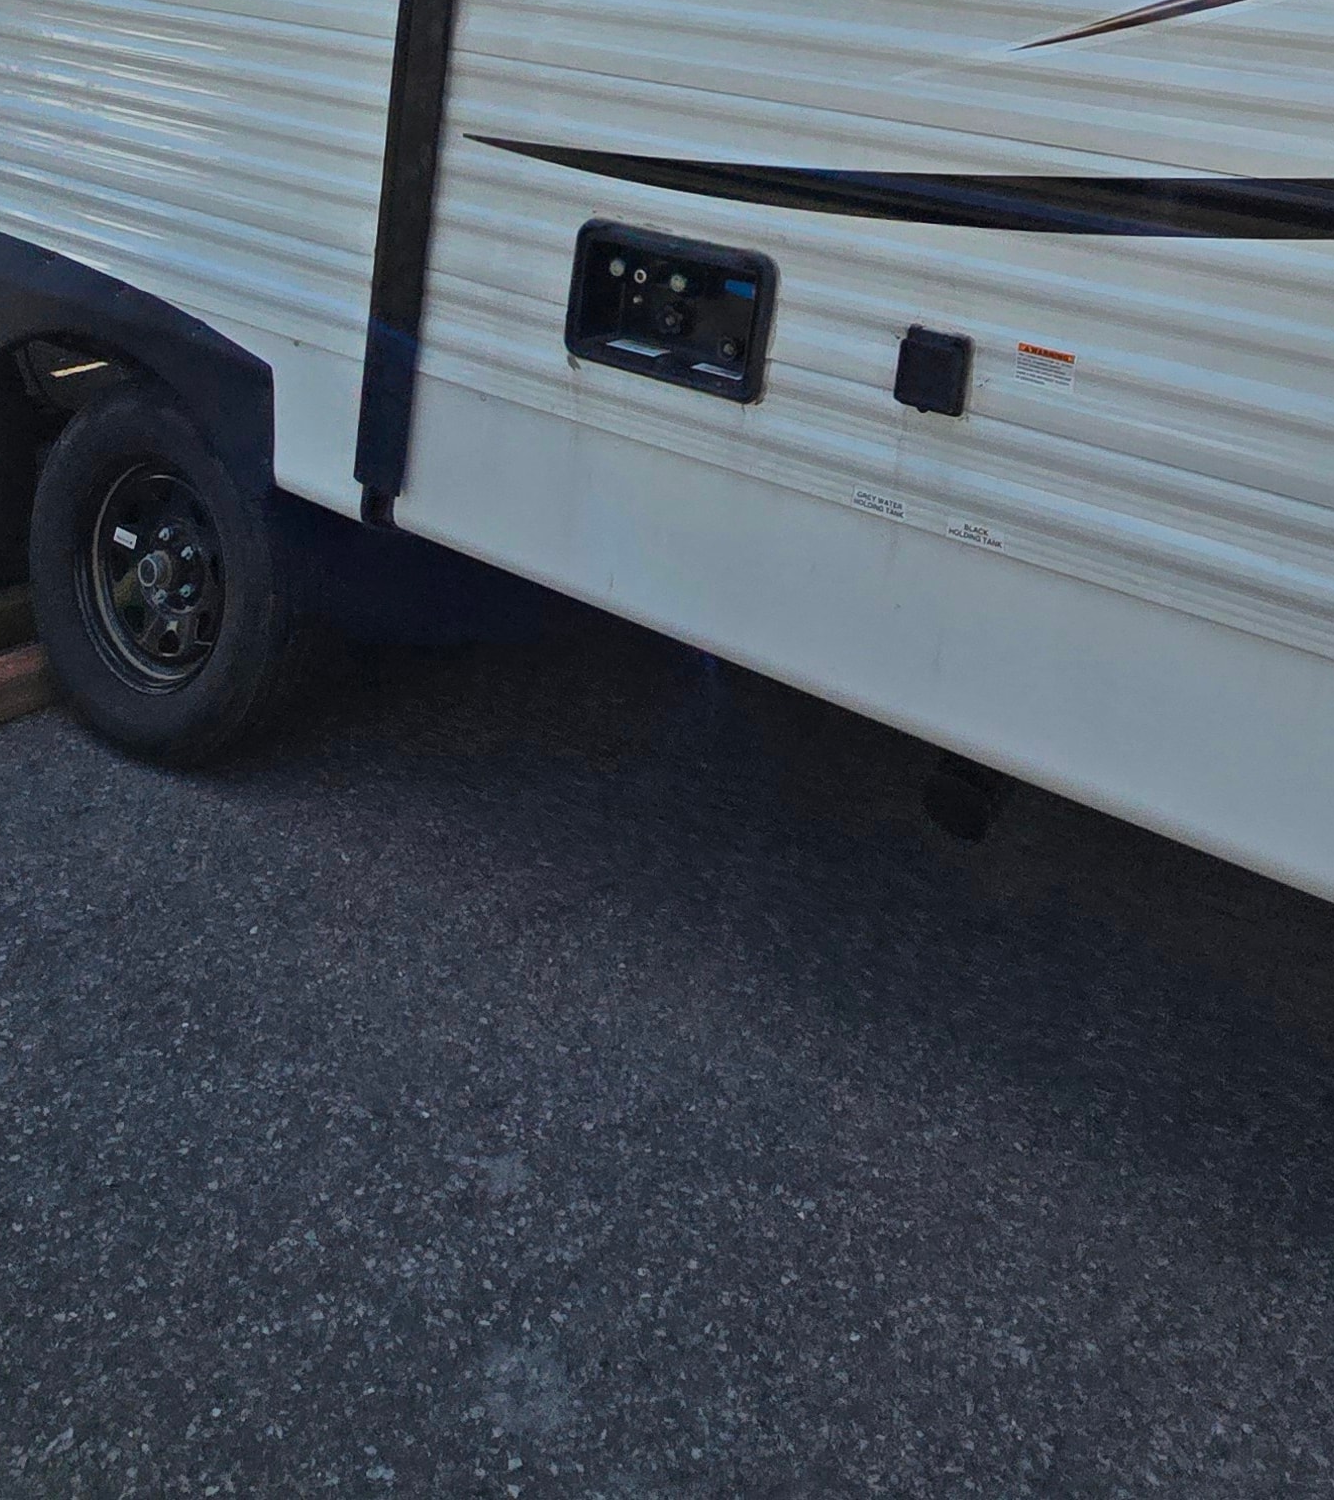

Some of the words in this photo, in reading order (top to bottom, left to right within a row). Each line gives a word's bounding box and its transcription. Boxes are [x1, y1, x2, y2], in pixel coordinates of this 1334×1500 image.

[854, 499, 884, 512] HOLDING
[886, 507, 905, 519] TANK
[877, 497, 903, 510] WATER
[948, 527, 981, 543] HOLDING
[983, 536, 1003, 548] TANK
[964, 523, 989, 536] BLACK
